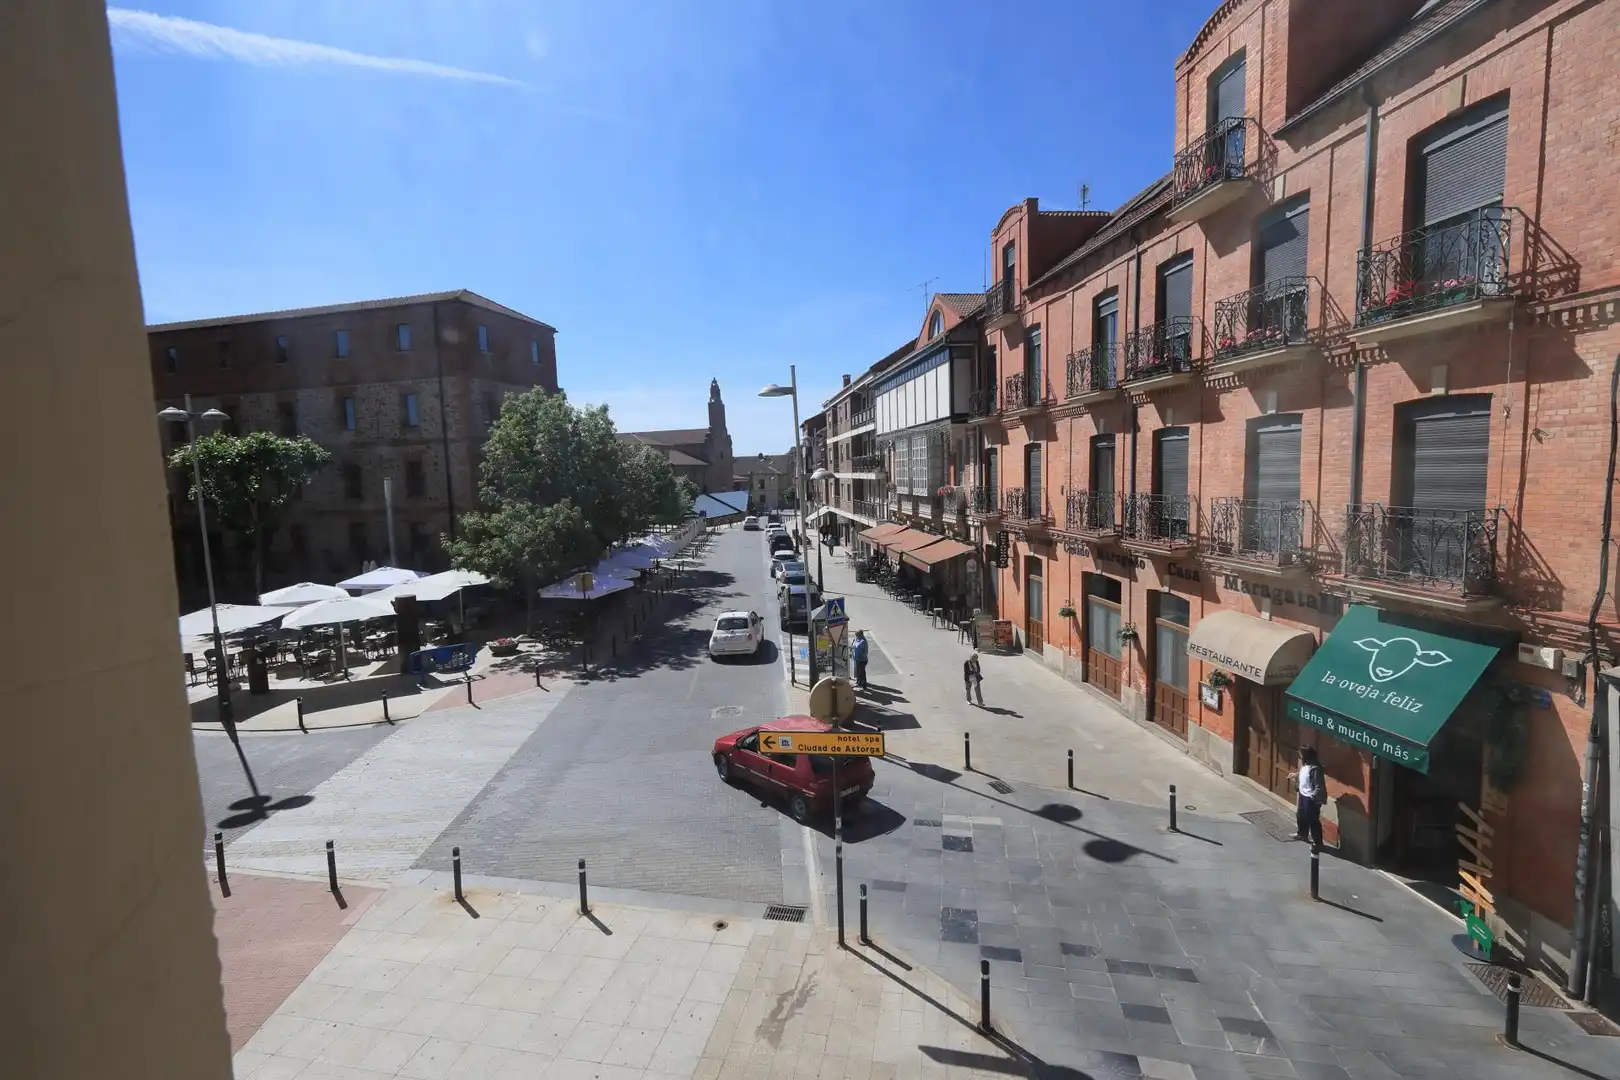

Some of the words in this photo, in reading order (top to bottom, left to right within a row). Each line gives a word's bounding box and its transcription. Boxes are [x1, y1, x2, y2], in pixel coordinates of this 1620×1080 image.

[1168, 562, 1200, 582] Casa
[1223, 575, 1319, 609] Maragata
[1189, 642, 1262, 677] RESTAURANTE
[1320, 670, 1336, 685] la
[1338, 679, 1380, 699] oveja
[1382, 691, 1424, 713] feliz
[797, 744, 828, 752] Ciudad
[831, 744, 841, 752] de
[845, 744, 880, 754] Astorga
[1300, 706, 1323, 725] lana
[1327, 718, 1335, 730] &
[1338, 723, 1378, 748] mucho
[1382, 741, 1409, 760] más
